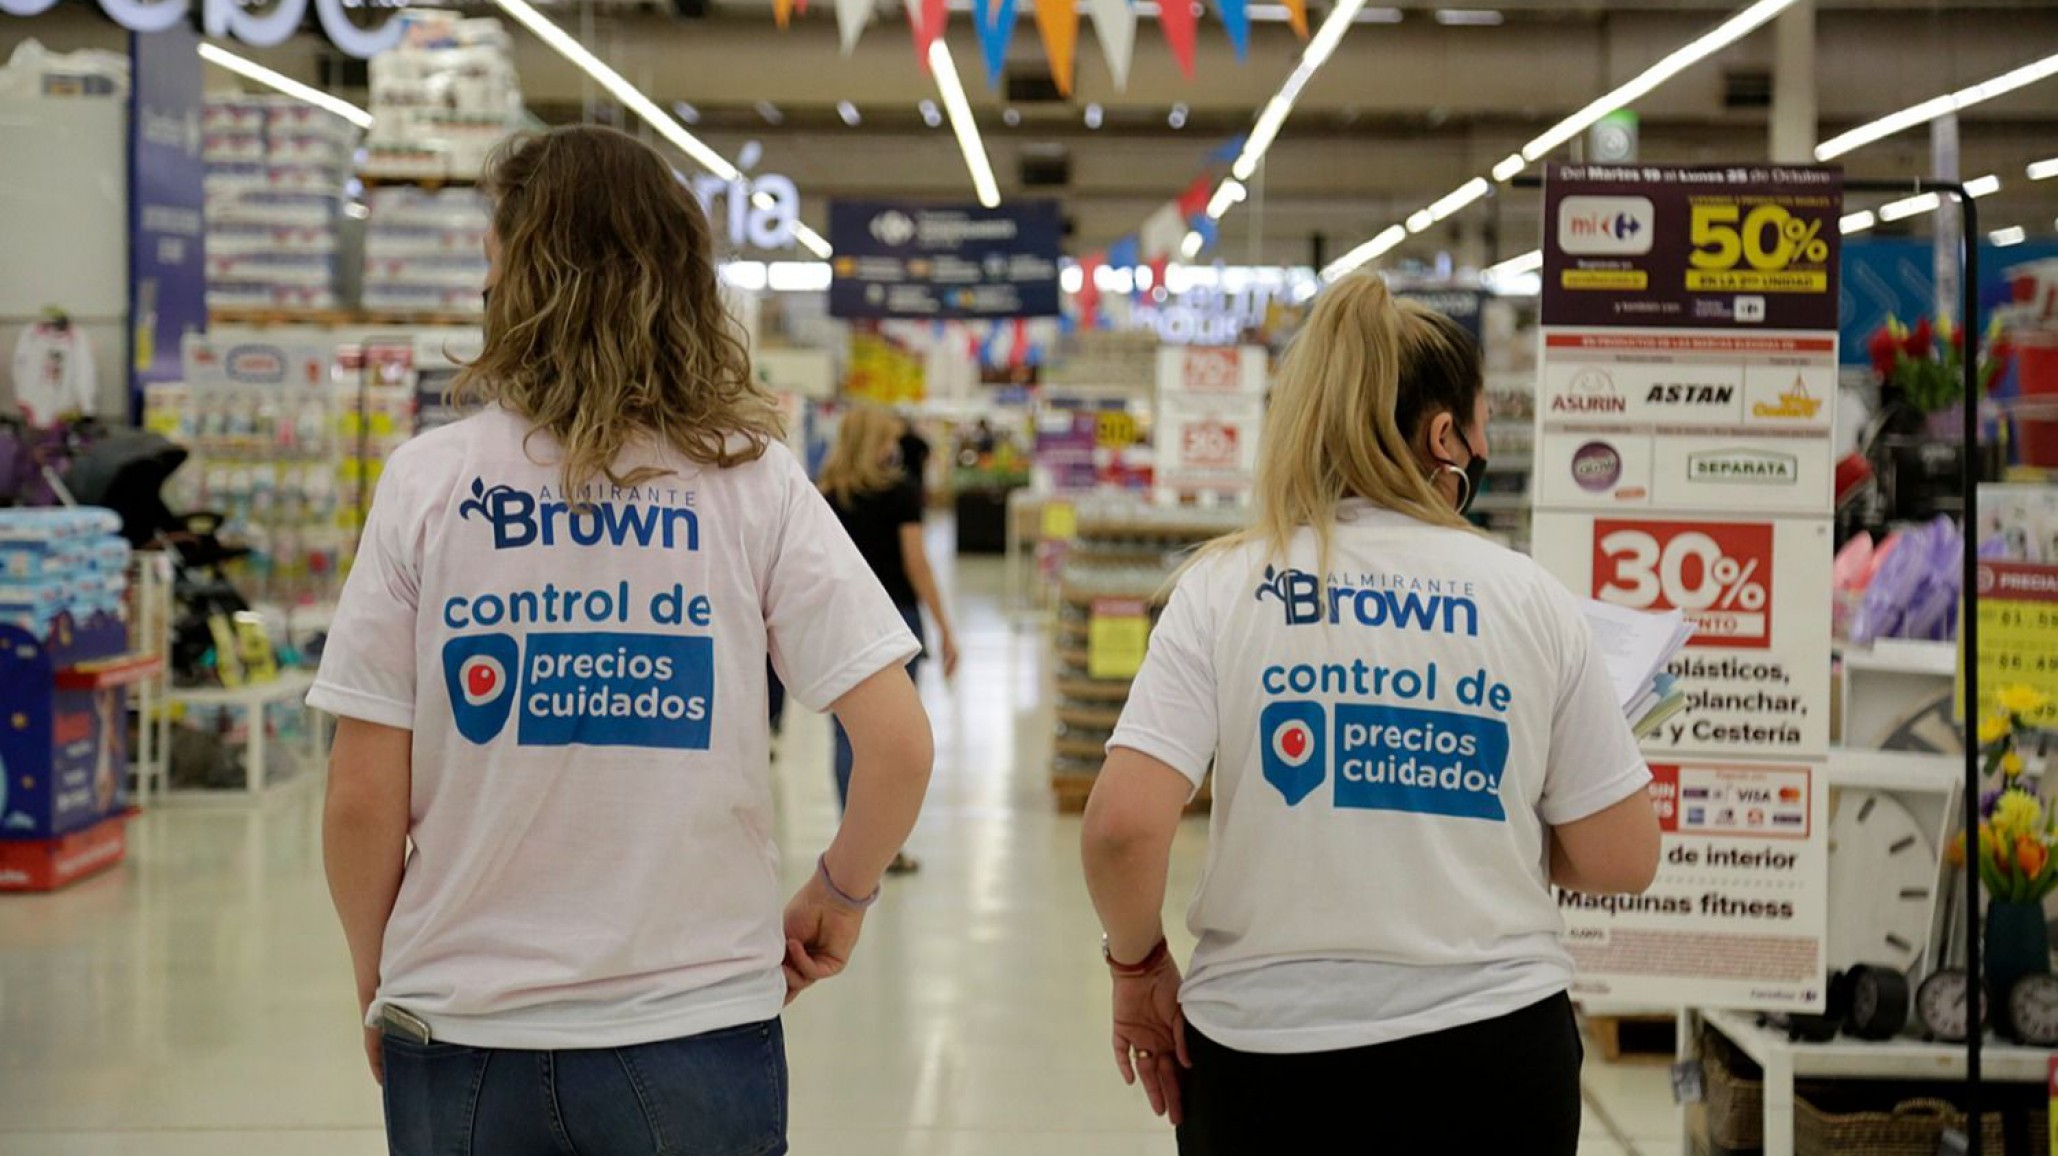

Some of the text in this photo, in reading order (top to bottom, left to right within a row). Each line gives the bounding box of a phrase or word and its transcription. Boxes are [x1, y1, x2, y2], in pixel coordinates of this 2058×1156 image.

[1560, 166, 1585, 182] Del
[1587, 166, 1639, 183] Martes
[1678, 169, 1724, 183] Lunes
[1688, 204, 1829, 271] 50%
[1552, 395, 1626, 413] ASURIN
[1647, 384, 1733, 405] ASTAN
[1697, 461, 1787, 476] SEPARATA
[492, 491, 699, 551] Brown
[1327, 572, 1475, 597] ALMIRANTE
[1597, 530, 1766, 610] 30%
[444, 580, 711, 629] control de
[1285, 573, 1478, 637] Brown
[530, 647, 673, 685] precios
[1262, 658, 1512, 711] control de
[528, 685, 706, 721] cuidados
[1344, 723, 1478, 756] precios
[1671, 723, 1685, 746] y
[1692, 720, 1801, 743] Cestería
[1342, 755, 1499, 795] cuidados
[1668, 844, 1798, 870] de interior
[1701, 893, 1794, 920] fitness
